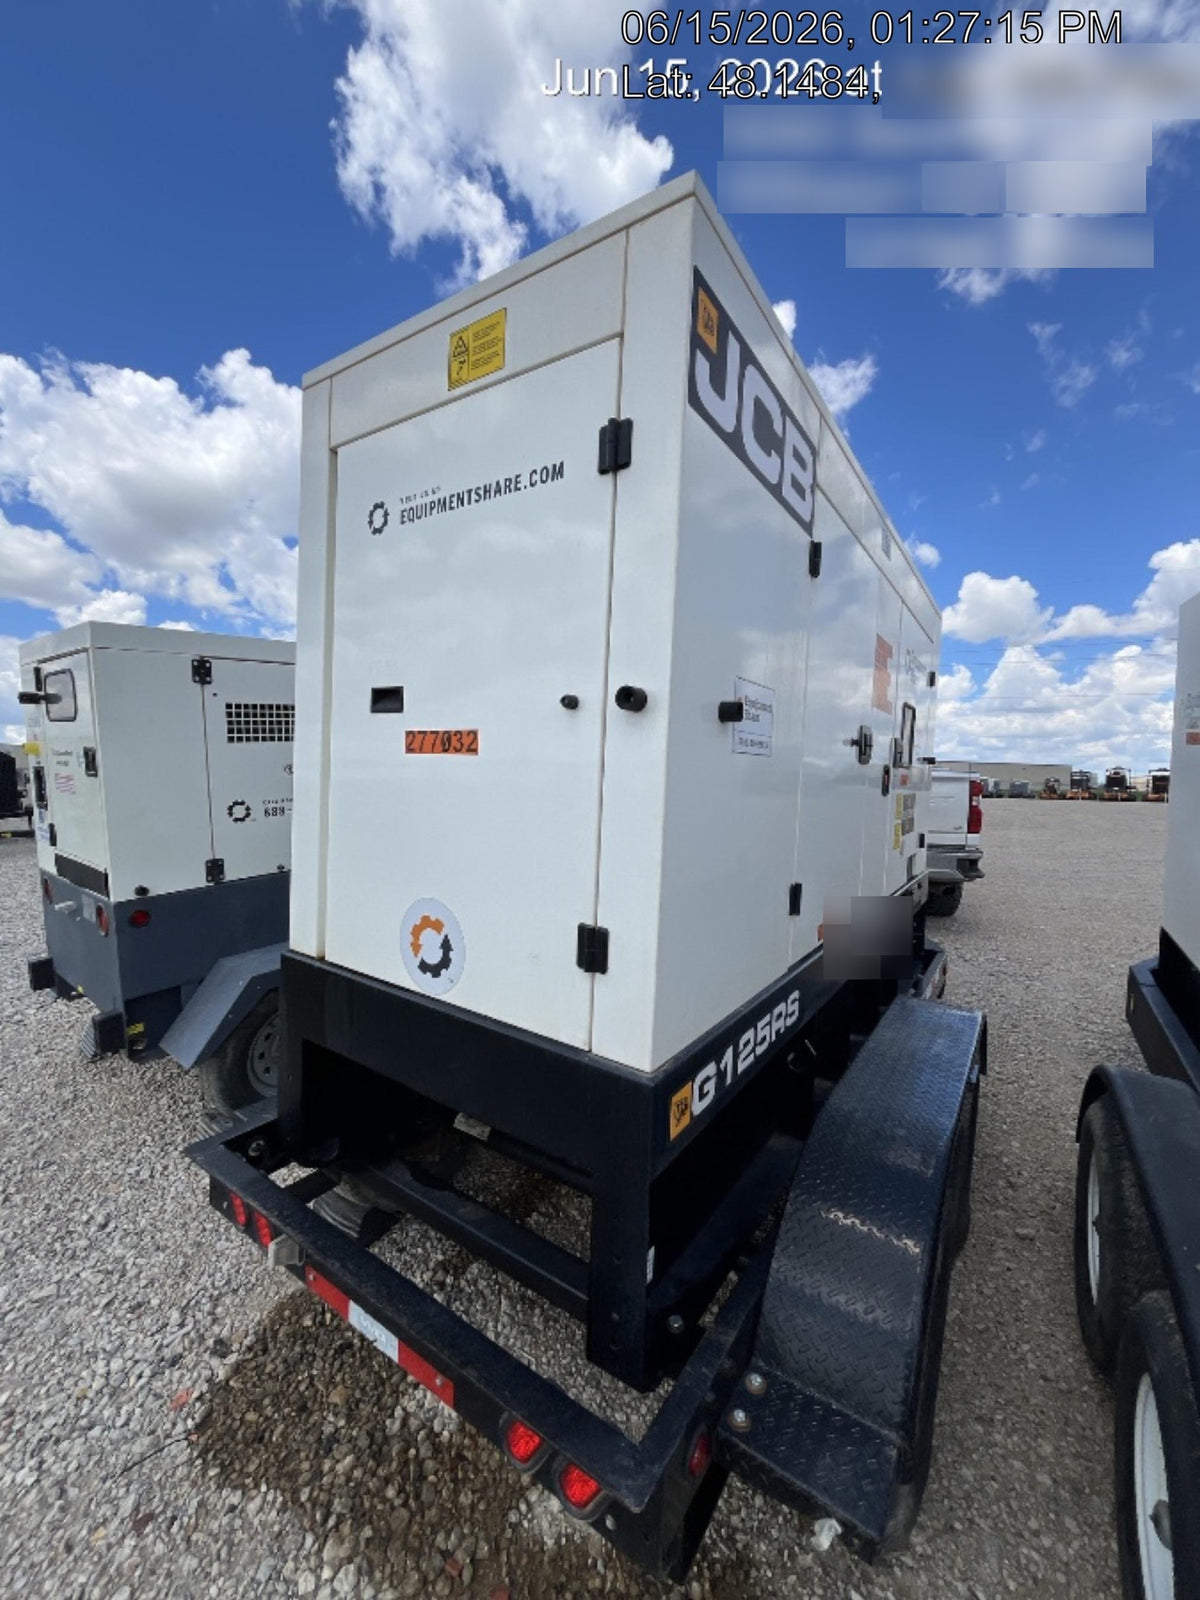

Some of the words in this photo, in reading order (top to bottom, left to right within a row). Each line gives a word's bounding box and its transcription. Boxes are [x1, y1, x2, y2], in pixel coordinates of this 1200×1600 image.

[695, 329, 814, 524] JCB
[400, 460, 565, 525] EQUIPMENTSHARE.COM
[405, 730, 478, 753] 277032
[692, 989, 800, 1116] G125RS
